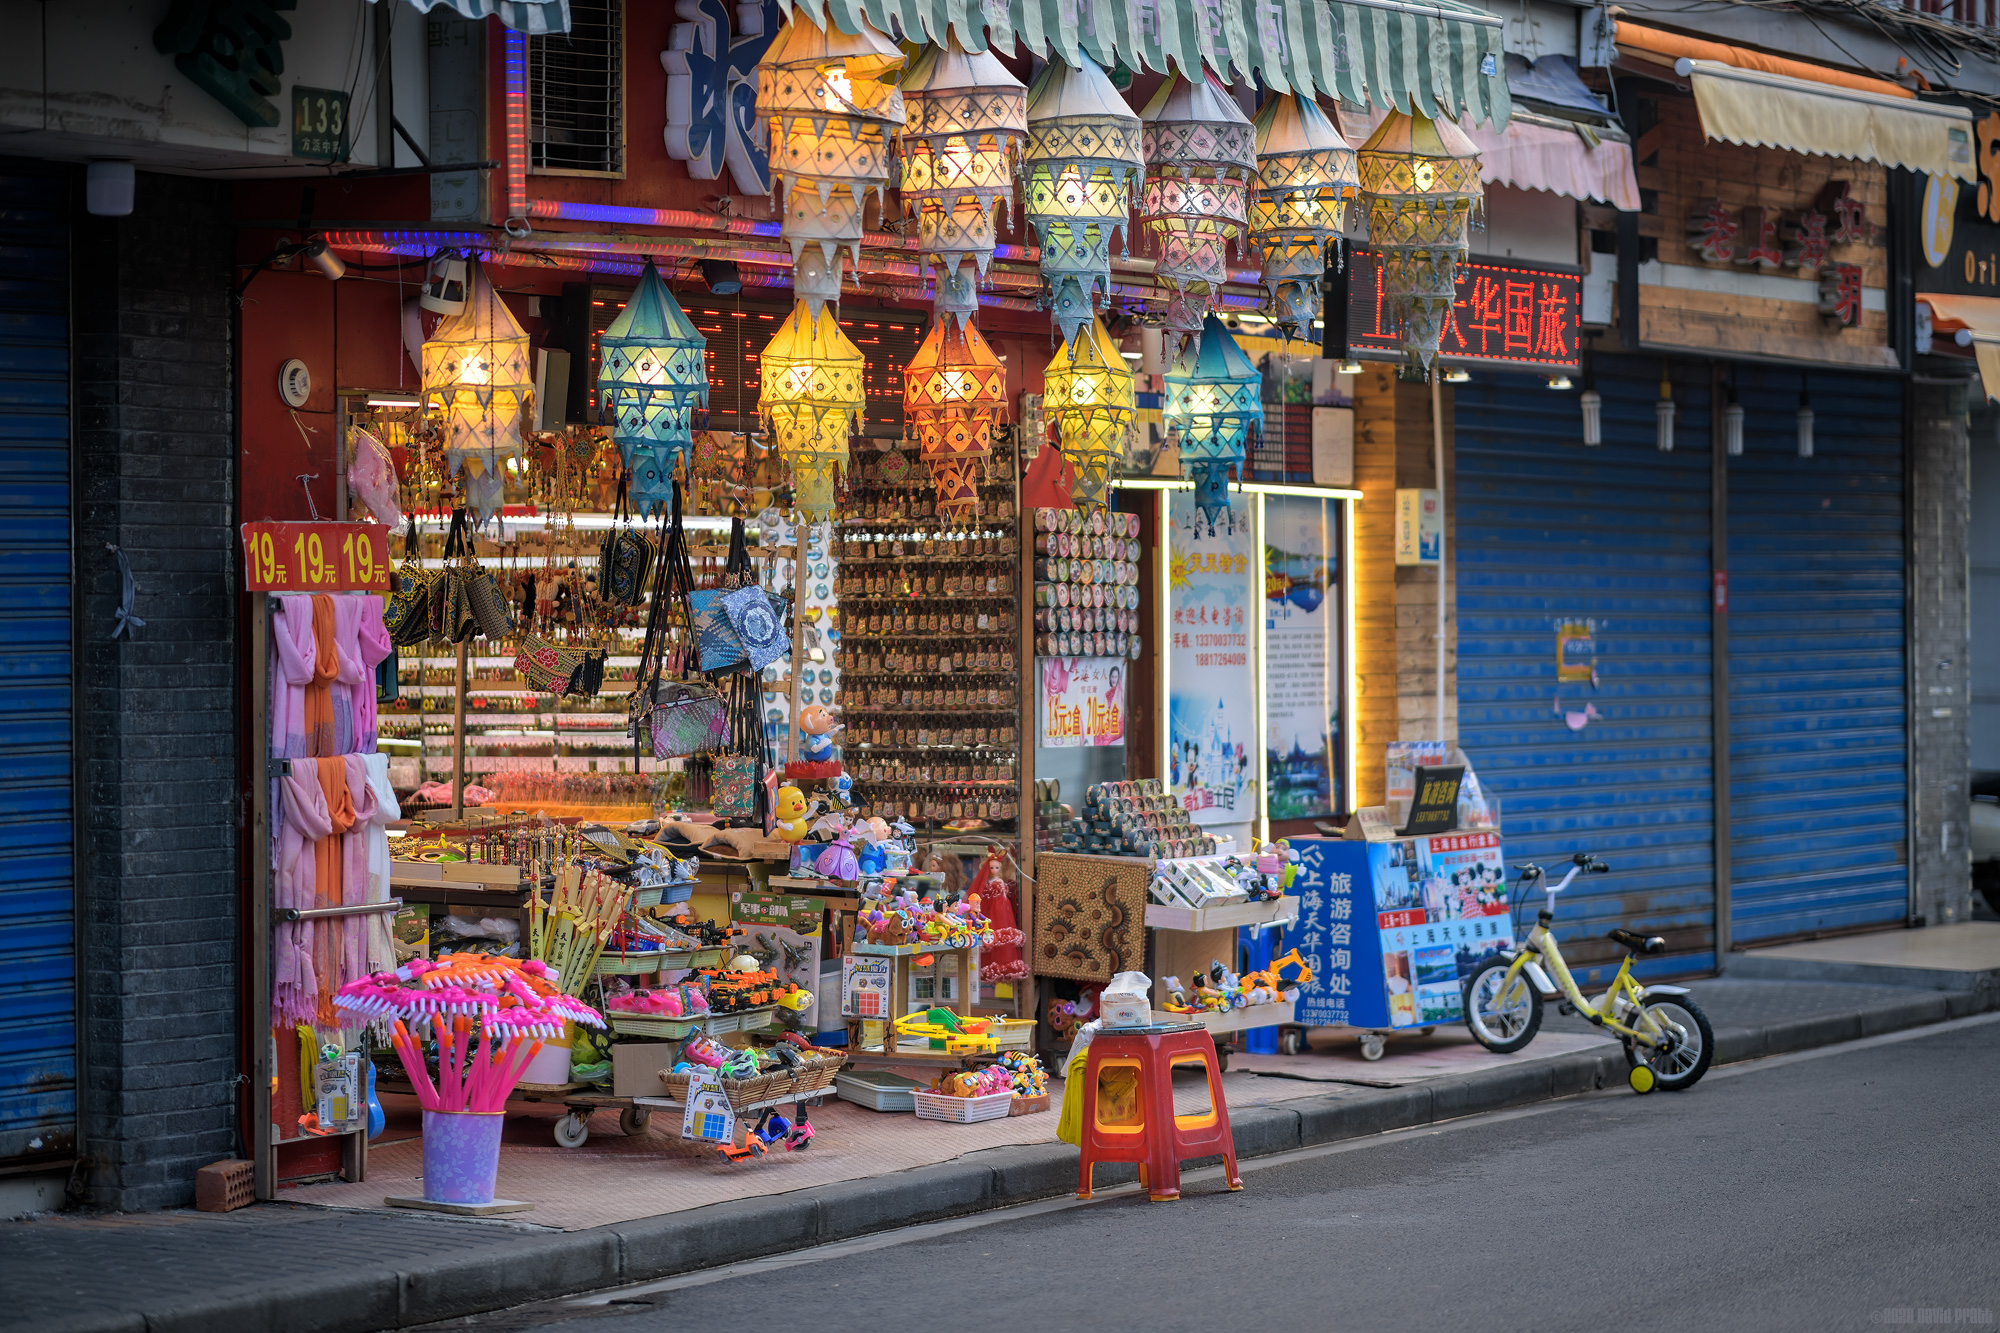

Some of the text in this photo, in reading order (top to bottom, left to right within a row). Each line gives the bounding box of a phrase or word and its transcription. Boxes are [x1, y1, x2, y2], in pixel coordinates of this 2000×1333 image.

[301, 97, 342, 135] 133
[1703, 197, 1829, 269] 老上海
[1964, 250, 2000, 286] Ori
[1361, 265, 1568, 356] 上天华国旅
[249, 532, 386, 584] 19元 19元 19元
[1189, 552, 1248, 574] 天天特价
[1174, 604, 1244, 627] 欢迎来电咨询
[1195, 652, 1247, 667] 18817264009
[1329, 872, 1352, 995] 旅游咨询处
[1301, 1008, 1349, 1019] 13370037732
[1306, 997, 1346, 1009] 热线电话
